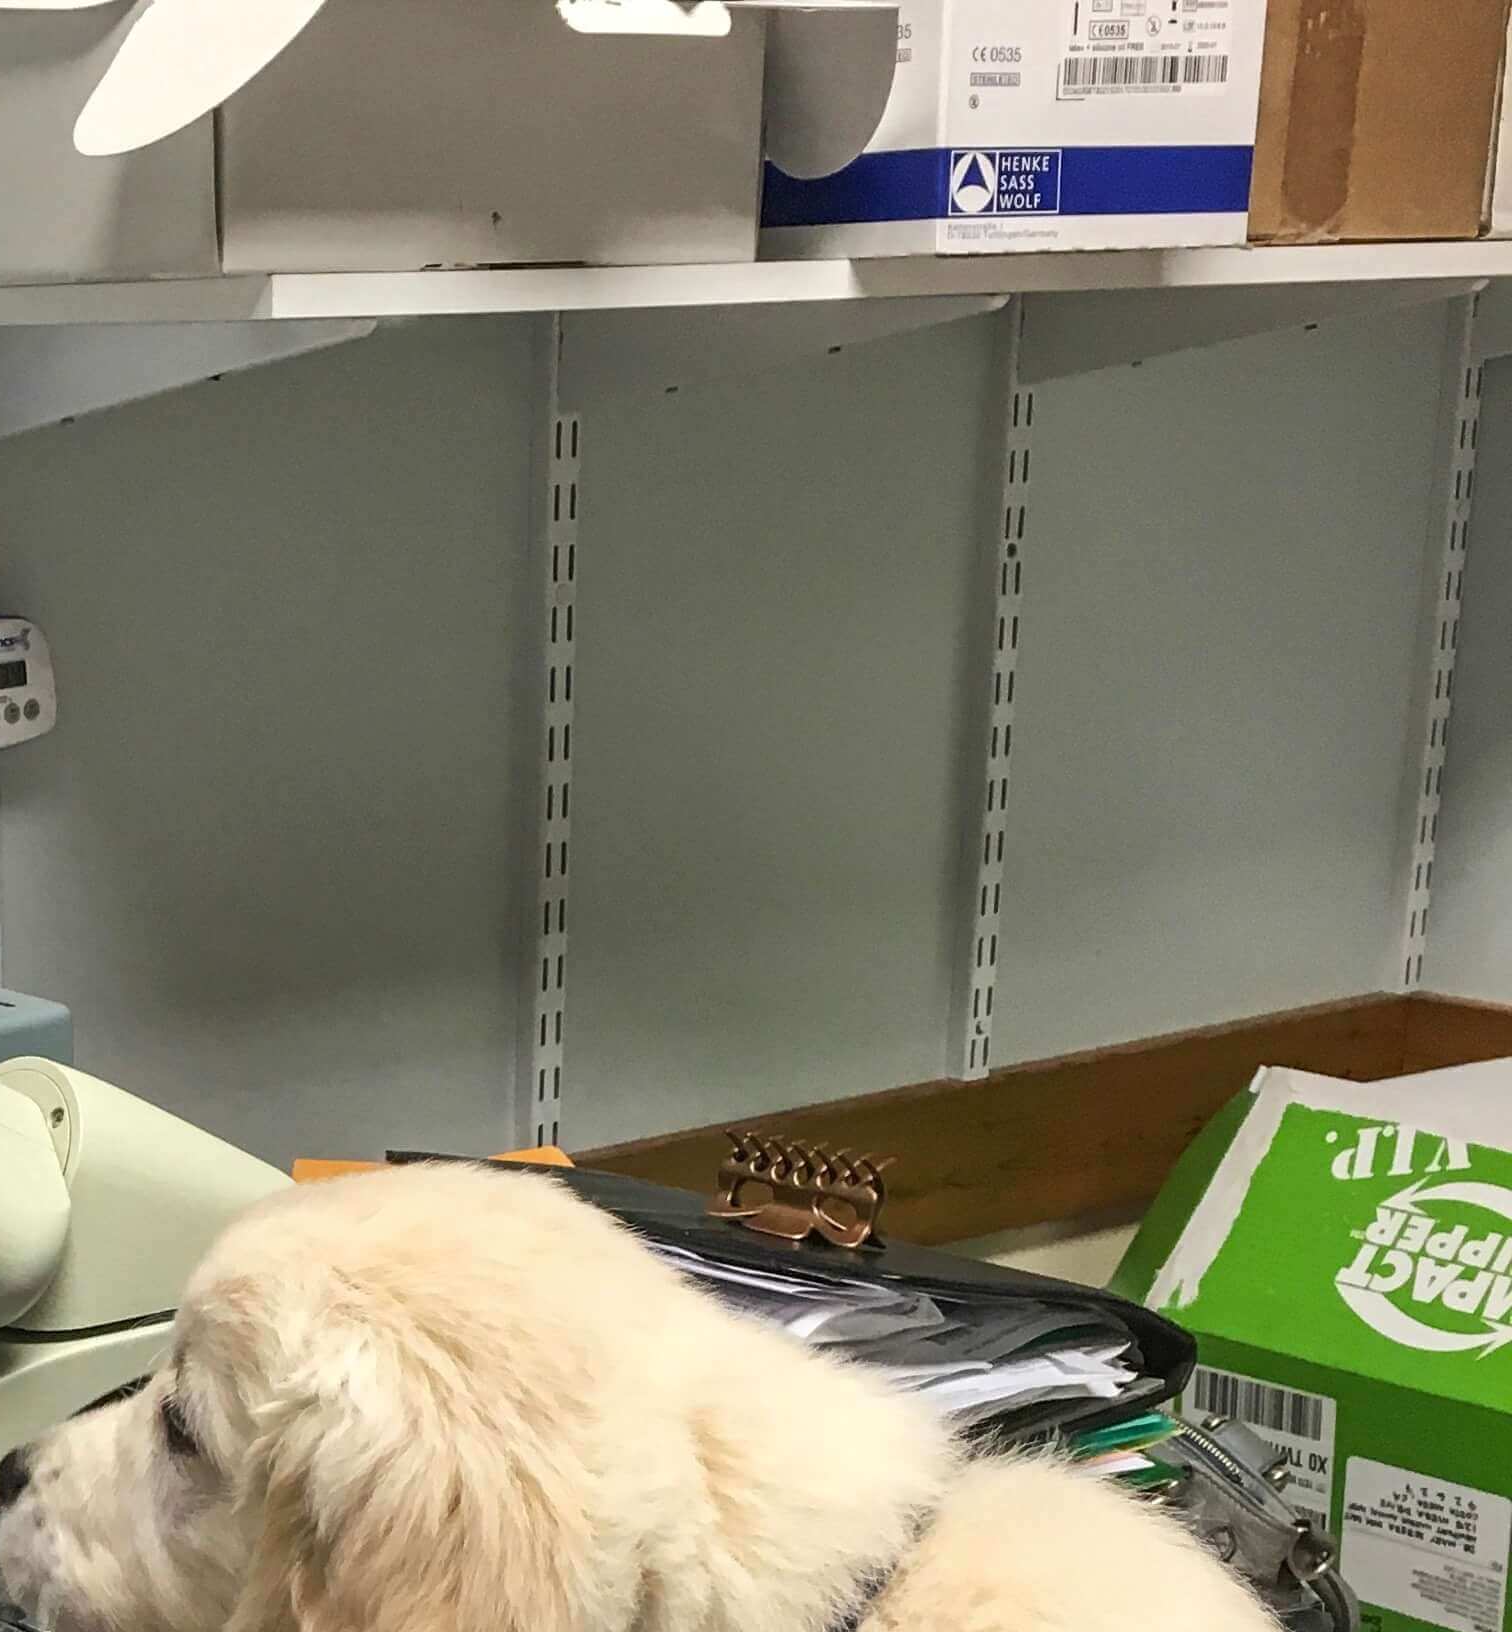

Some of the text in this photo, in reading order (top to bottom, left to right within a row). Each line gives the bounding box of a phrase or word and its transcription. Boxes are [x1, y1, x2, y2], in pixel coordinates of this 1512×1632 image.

[990, 47, 1022, 63] 0535
[1001, 155, 1050, 172] HENKE
[1000, 174, 1035, 191] SASS
[999, 193, 1041, 209] WOLF
[1326, 1124, 1472, 1180] VI.P.
[1366, 1207, 1512, 1276] IPPER
